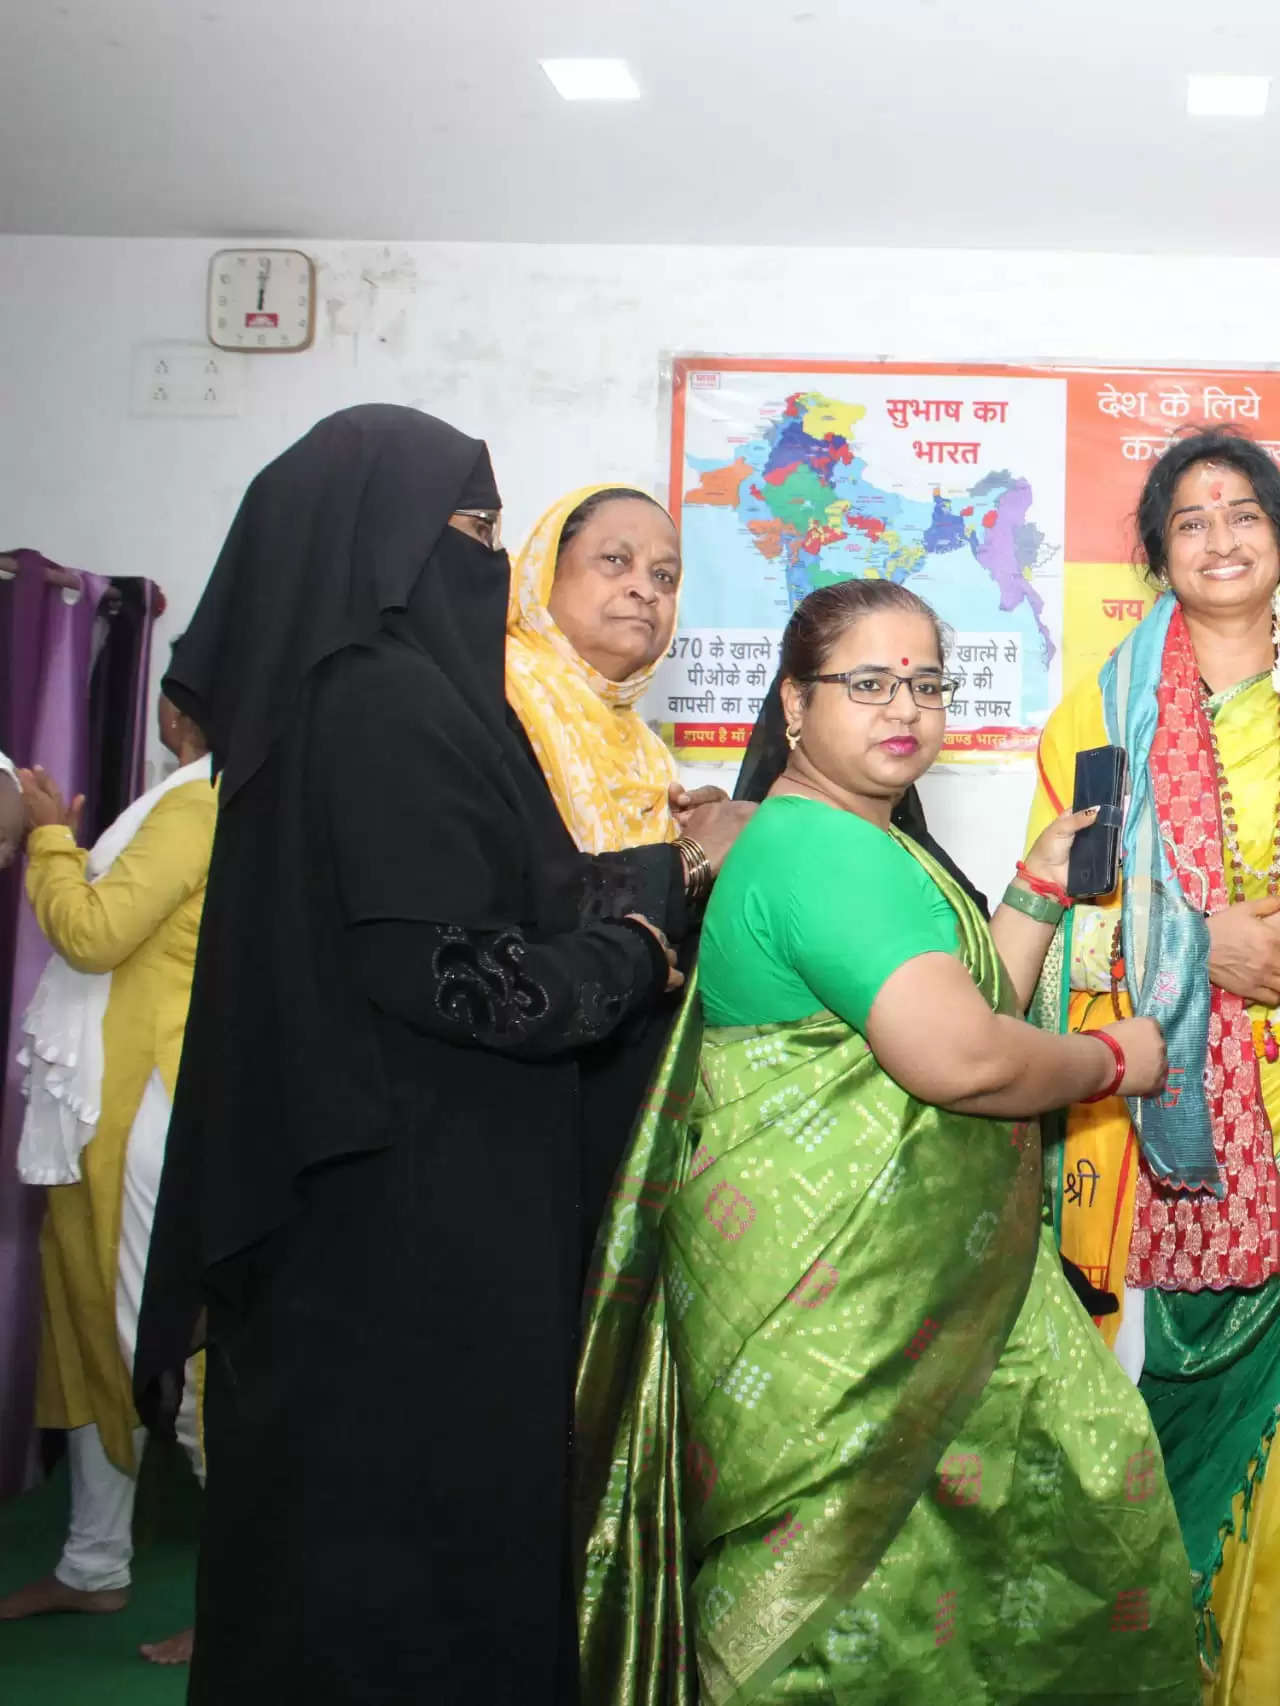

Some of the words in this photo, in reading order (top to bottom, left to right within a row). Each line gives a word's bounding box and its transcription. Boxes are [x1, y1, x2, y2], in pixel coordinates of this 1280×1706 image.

[886, 399, 963, 429] सुभाष
[972, 401, 1008, 423] का
[1097, 384, 1148, 418] देश
[1158, 384, 1191, 417] के
[1202, 386, 1262, 419] लिये
[912, 440, 981, 464] भारत
[1102, 599, 1144, 621] जय
[709, 635, 725, 658] के
[730, 636, 772, 660] खात्मे
[956, 639, 998, 663] खात्मे
[1004, 639, 1017, 663] से
[687, 662, 742, 687] पीओके
[745, 663, 767, 687] की
[972, 665, 994, 689] की
[668, 689, 715, 713] वापसी
[721, 697, 742, 714] का
[974, 700, 1011, 717] सफर
[1064, 1158, 1100, 1208] श्री
